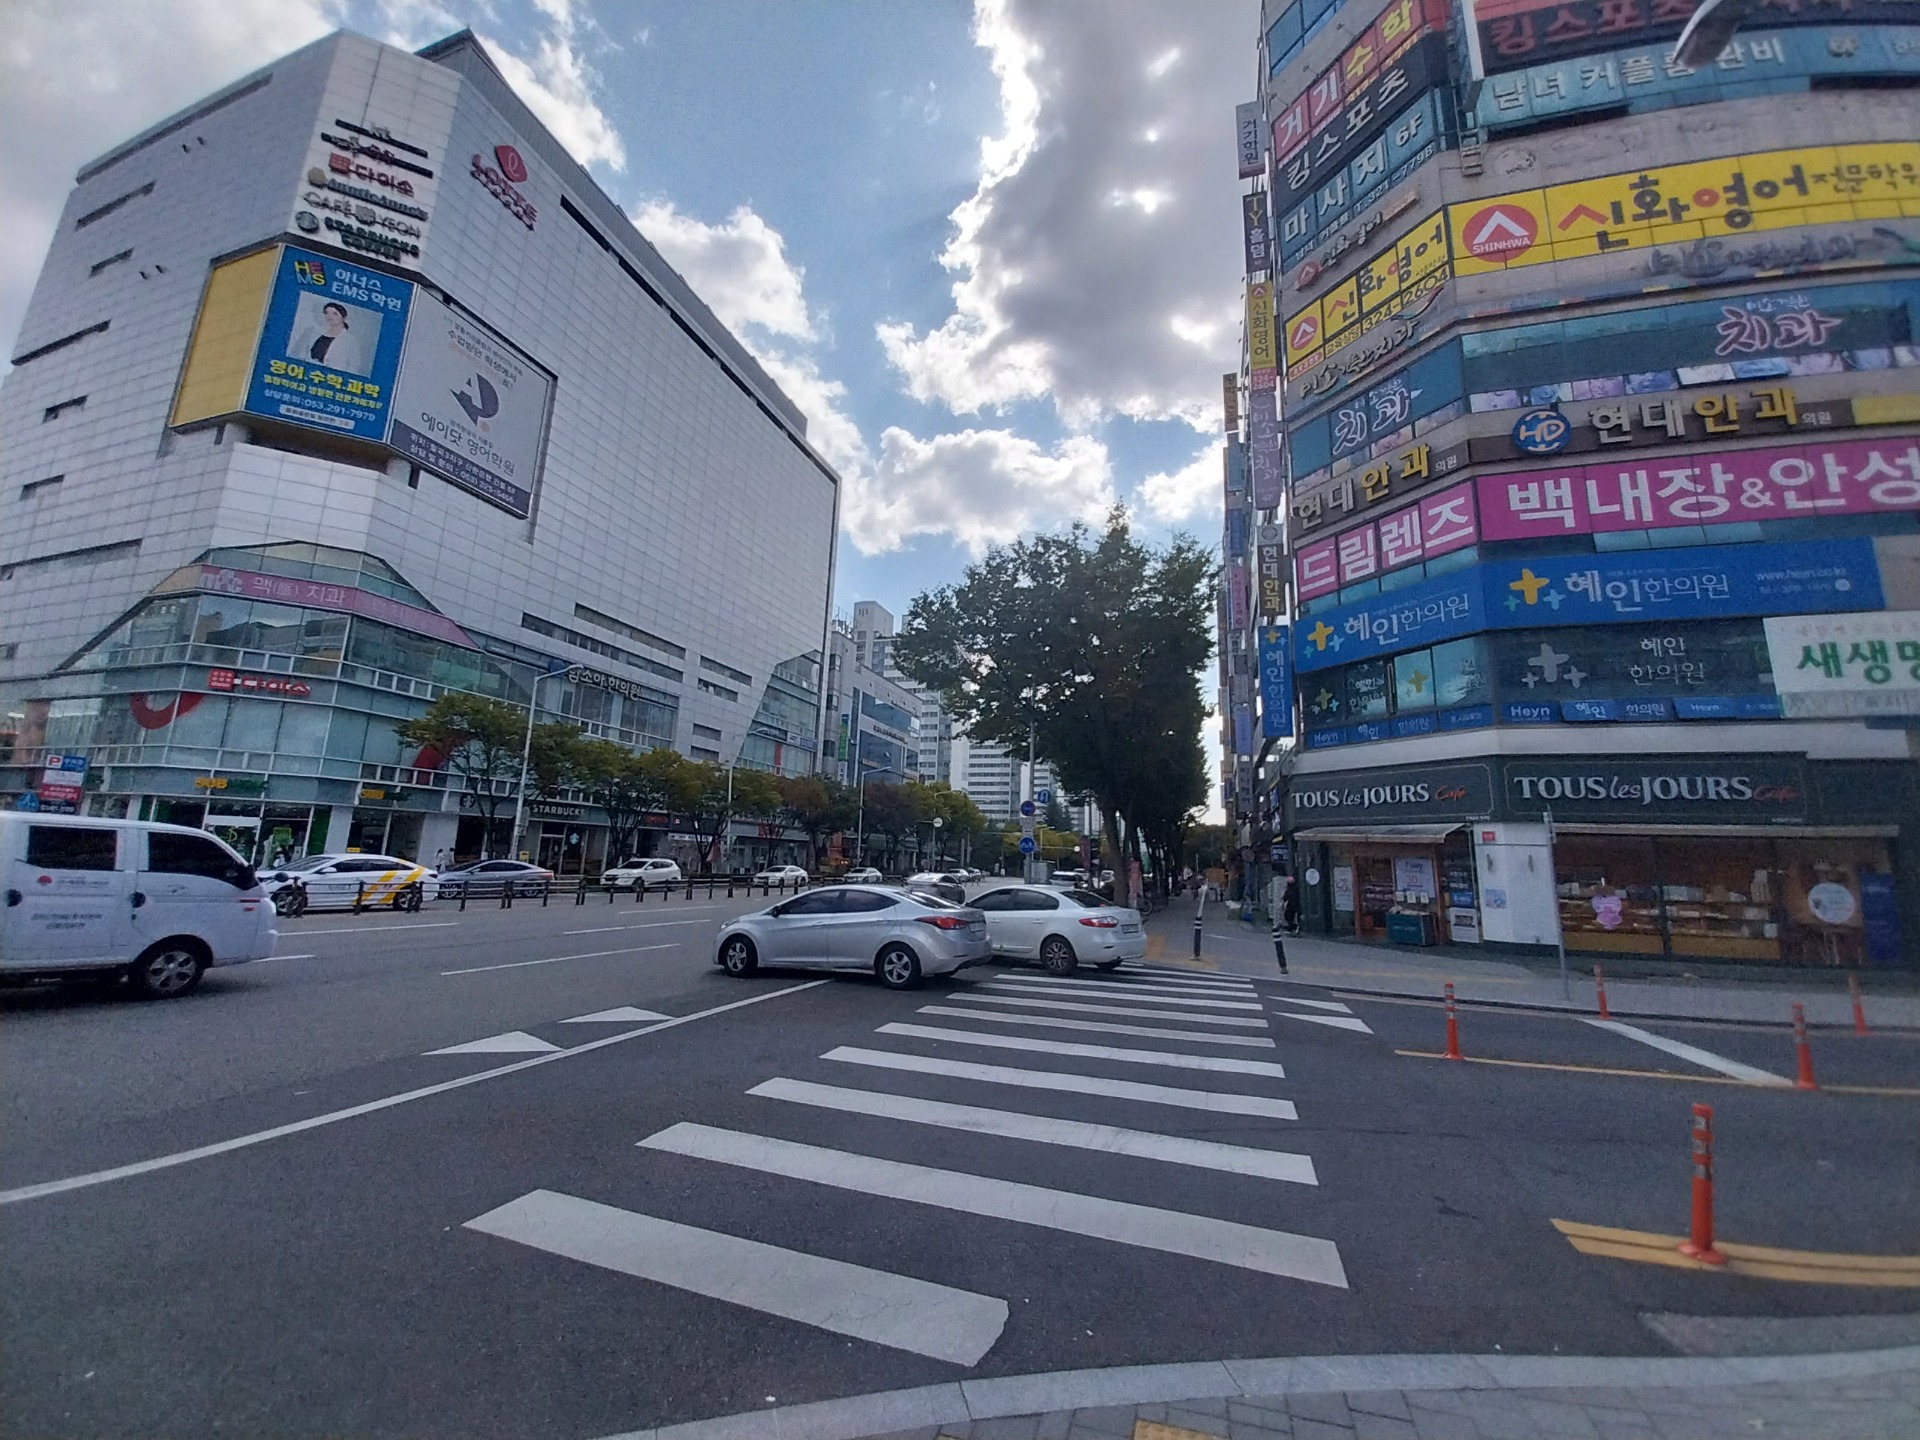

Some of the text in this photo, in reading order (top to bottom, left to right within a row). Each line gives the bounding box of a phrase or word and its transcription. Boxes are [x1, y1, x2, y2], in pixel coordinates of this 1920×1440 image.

[1493, 71, 1566, 111] 남녀
[1287, 68, 1410, 190] 킹스포츠
[354, 163, 415, 198] 다이소
[1284, 138, 1387, 242] 마사지
[1395, 113, 1425, 147] 6F
[1557, 164, 1809, 250] 신화영어
[324, 216, 420, 258] STARBUCKS
[1472, 234, 1531, 255] SHINHWA
[335, 268, 383, 292] 아너스
[1327, 222, 1444, 323] 신화영어
[1364, 266, 1450, 335] 324-2604
[1252, 300, 1268, 359] 신화영어
[1715, 306, 1844, 356] 치과
[1332, 387, 1411, 455] 치과
[1590, 387, 1832, 443] 현대안과 의원
[467, 437, 516, 478] 영어학원
[1297, 443, 1458, 530] 현대안과 의원
[1300, 497, 1474, 593] 드림렌즈
[307, 584, 347, 606] 치과
[1262, 545, 1281, 613] 현대안과
[1565, 570, 1731, 613] 혜인한의원
[1343, 592, 1470, 646] 혜인한의원
[1640, 636, 1686, 657] 혜인
[1265, 650, 1287, 729] 혜인한의원
[1629, 662, 1705, 686] 한의원
[1358, 723, 1380, 740] 혜인
[1510, 705, 1550, 719] Heyn
[1575, 702, 1665, 719] 혜인 한의원
[1314, 731, 1339, 745] Heyn
[532, 803, 586, 817] STARBUCKS
[1291, 790, 1341, 809] TOUS
[1342, 787, 1362, 806] les
[1362, 783, 1430, 809] JOURS
[1512, 776, 1606, 800] TOUS
[1608, 774, 1643, 800] les
[1640, 775, 1754, 805] JOURS
